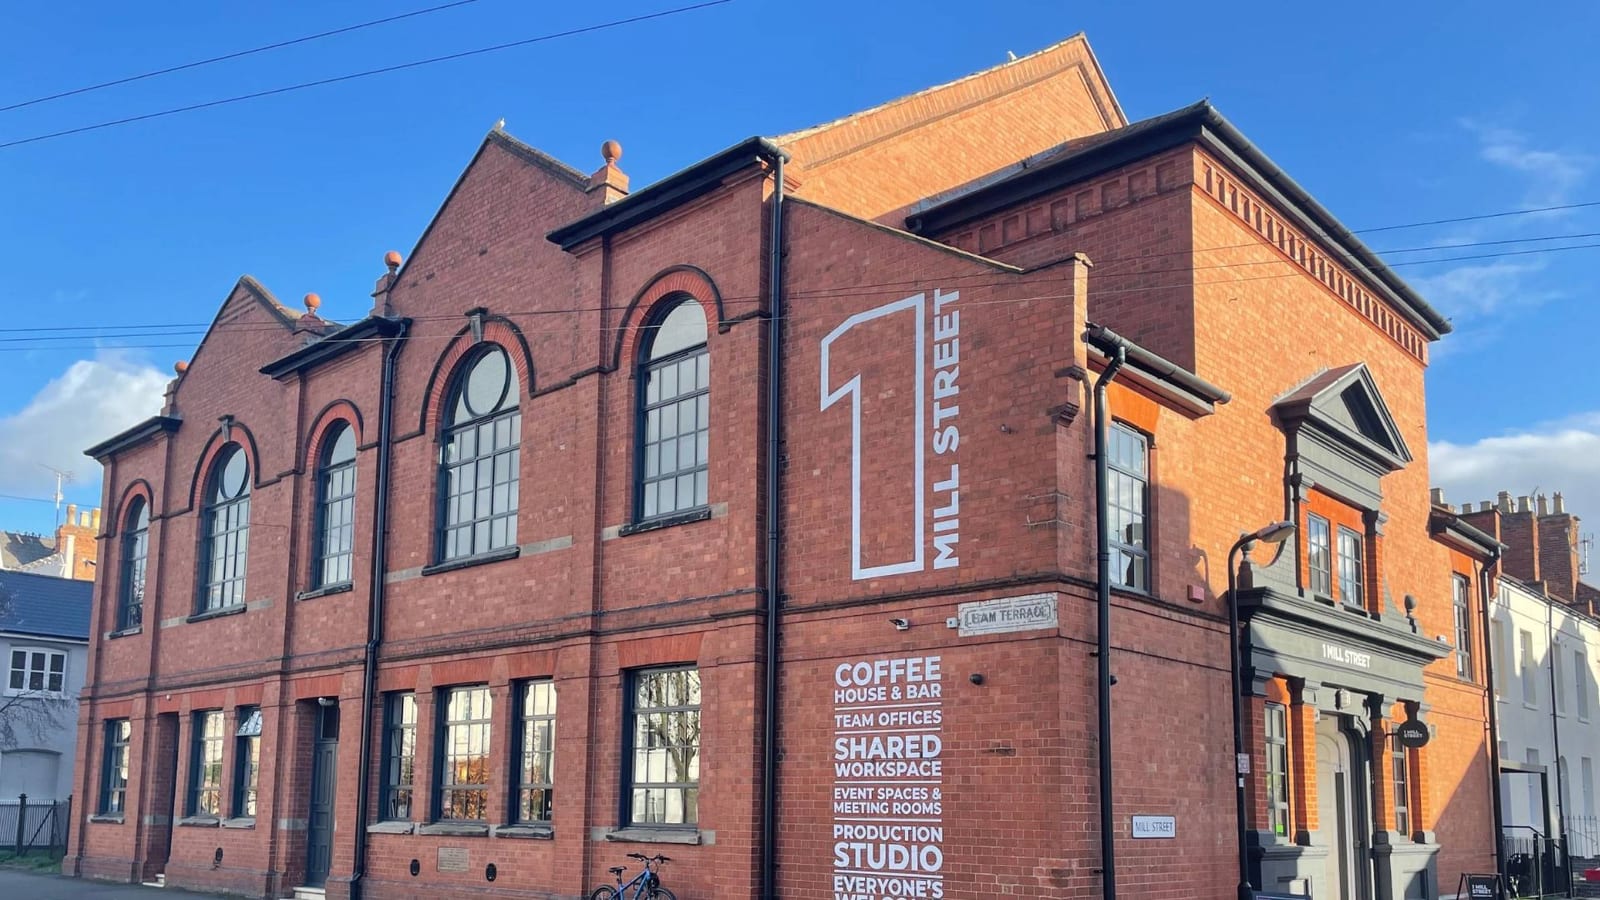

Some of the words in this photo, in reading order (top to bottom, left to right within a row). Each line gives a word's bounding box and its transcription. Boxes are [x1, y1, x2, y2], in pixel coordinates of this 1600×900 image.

[933, 288, 960, 454] STREET
[821, 292, 925, 580] 1
[933, 464, 959, 570] MILL
[1322, 643, 1327, 658] 1
[1327, 645, 1344, 662] MILL
[1344, 650, 1371, 668] STREET
[835, 656, 941, 687] COFFEE
[834, 686, 887, 703] HOUSE
[891, 686, 901, 700] &
[906, 683, 942, 699] BAR
[834, 713, 874, 728] TEAM
[878, 710, 942, 726] OFFICES
[834, 734, 942, 760] SHARED
[834, 760, 942, 777] WORKSPACE
[834, 788, 875, 800] EVENT
[877, 788, 928, 800] SPACES
[932, 788, 942, 800] &
[833, 802, 889, 814] MEETING
[892, 802, 942, 815] ROOMS
[833, 824, 943, 842] PRODUCTION
[1135, 821, 1149, 832] MILL
[1152, 821, 1173, 832] STREET
[833, 842, 943, 872] STUDIO
[833, 876, 944, 899] EVERYONE'S
